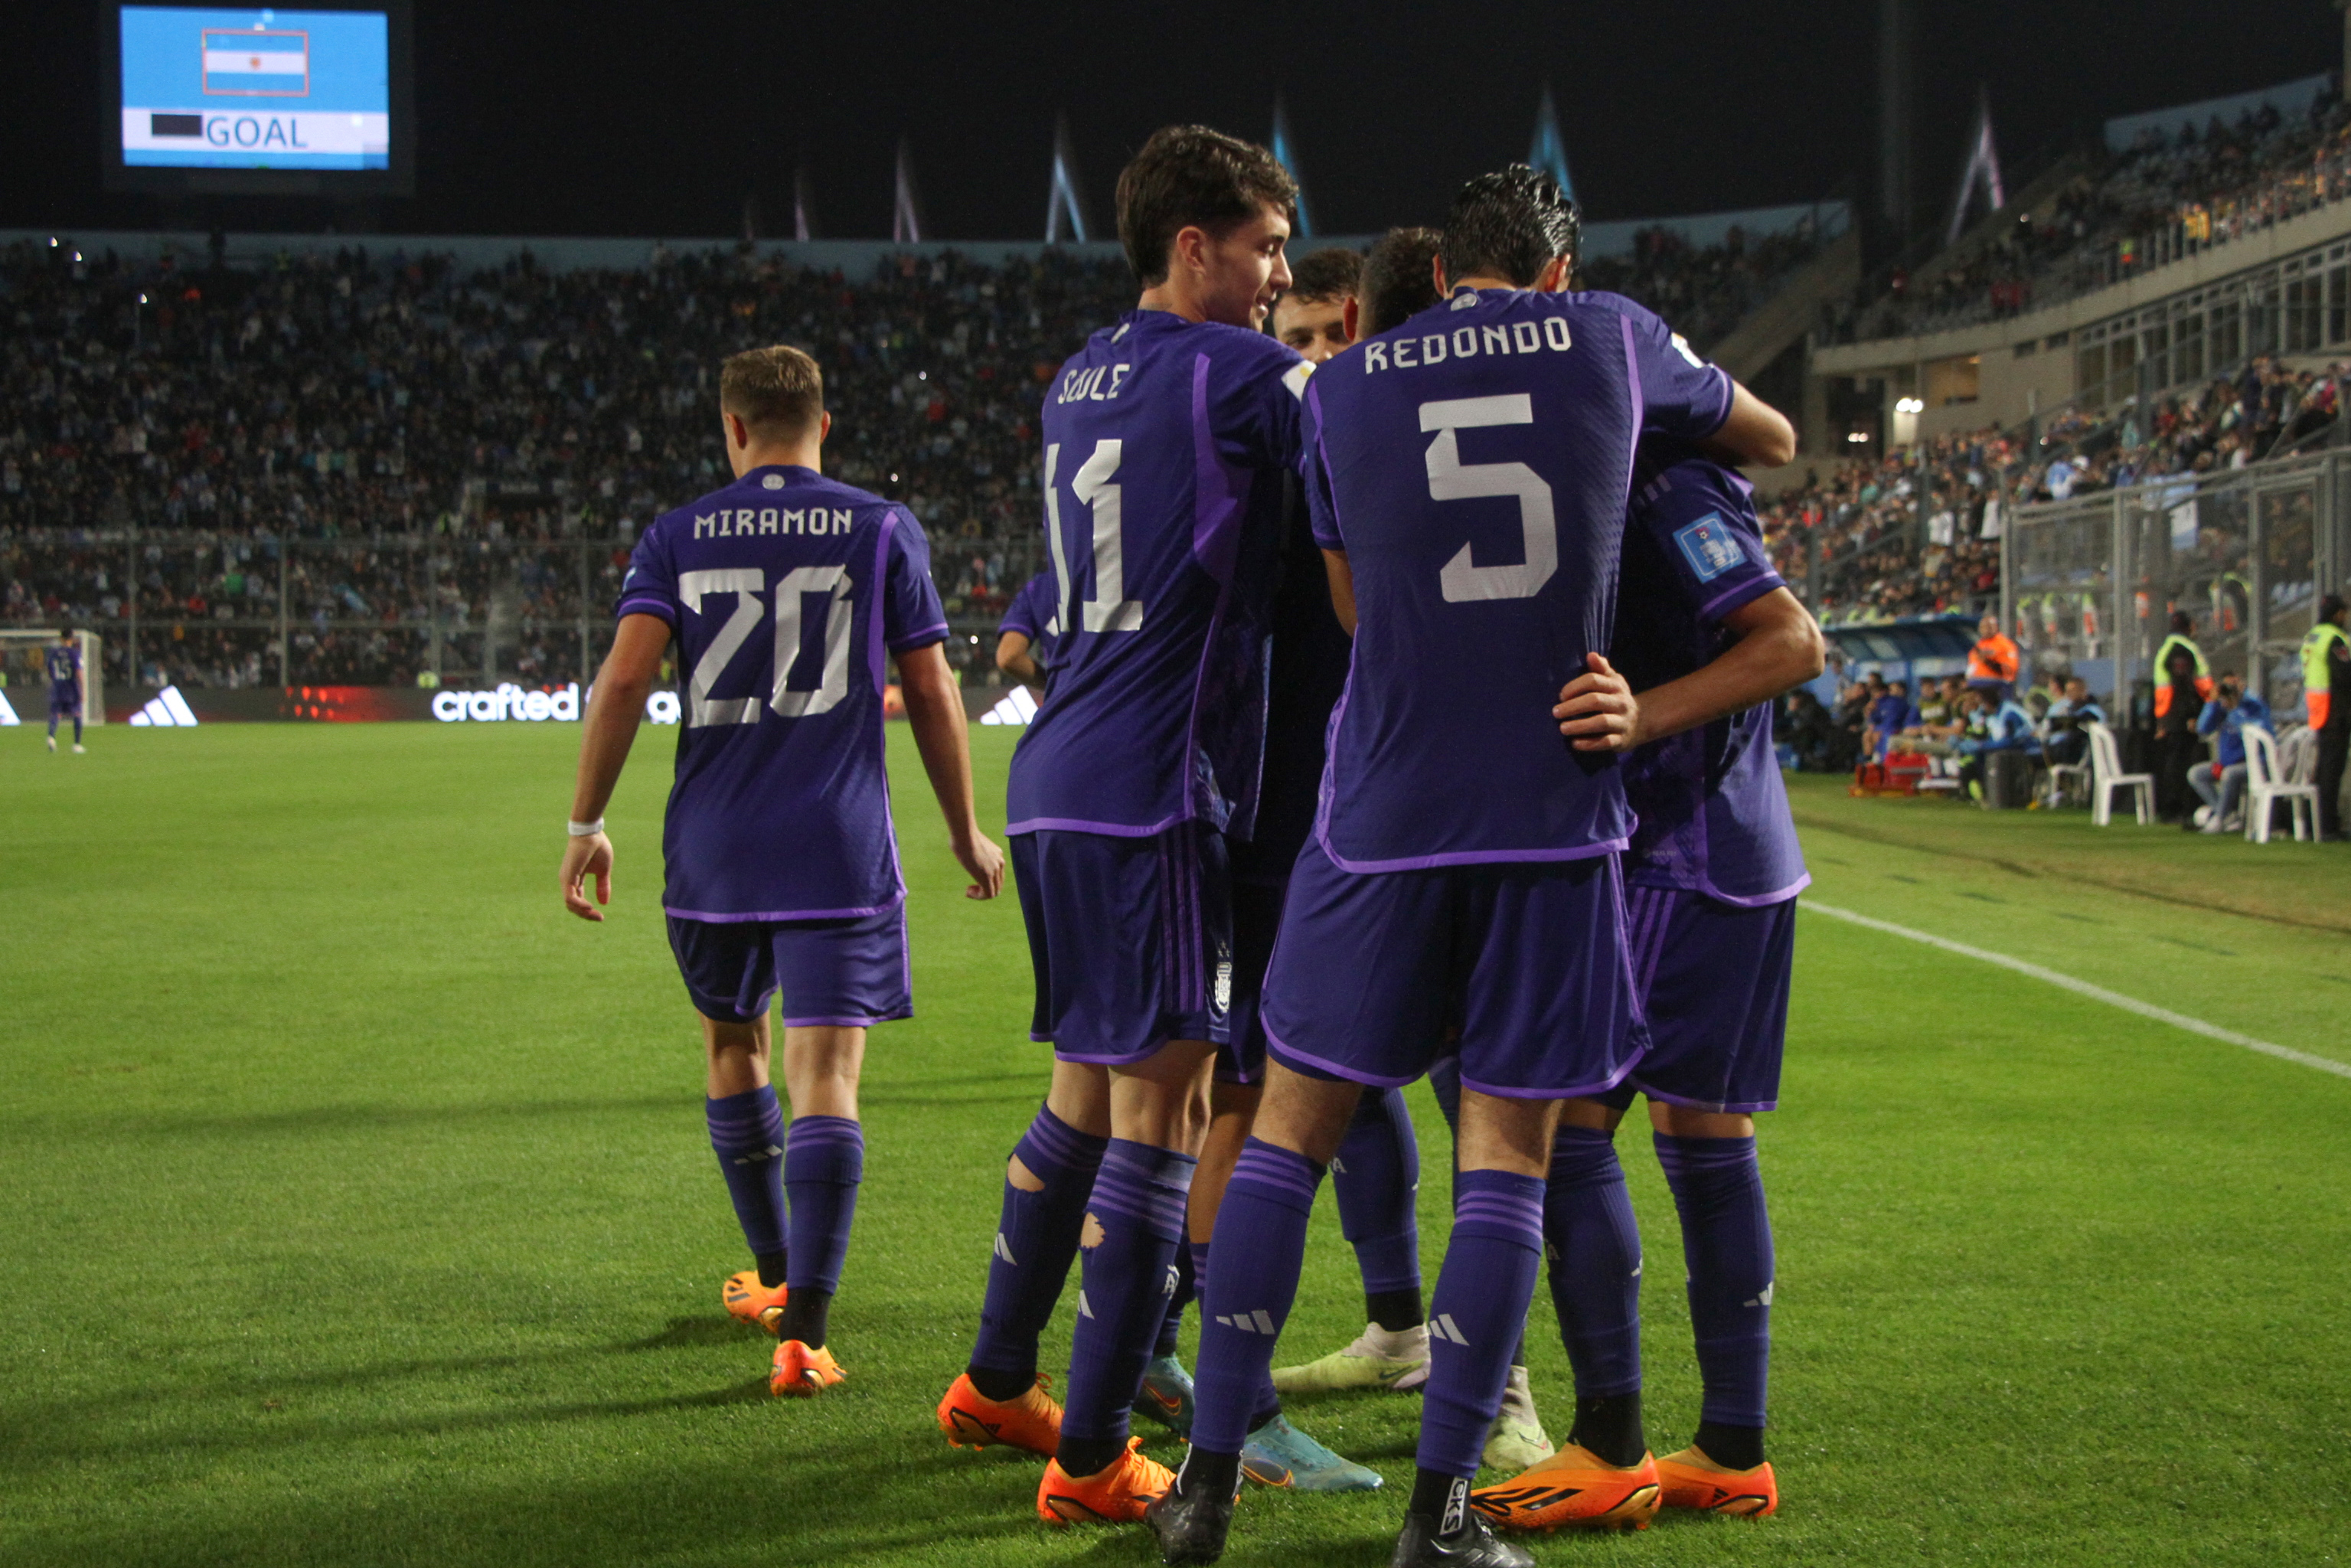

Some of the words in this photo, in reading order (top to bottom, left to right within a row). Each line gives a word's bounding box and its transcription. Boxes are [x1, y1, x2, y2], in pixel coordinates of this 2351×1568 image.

[206, 116, 309, 147] GOAL
[1364, 316, 1572, 374] REDONDO
[1057, 363, 1131, 405] SOULE
[1418, 392, 1559, 603] 5
[694, 507, 853, 540] MIRAMON
[1044, 438, 1144, 632] 11
[678, 563, 854, 729] 20
[432, 681, 580, 722] crafted
